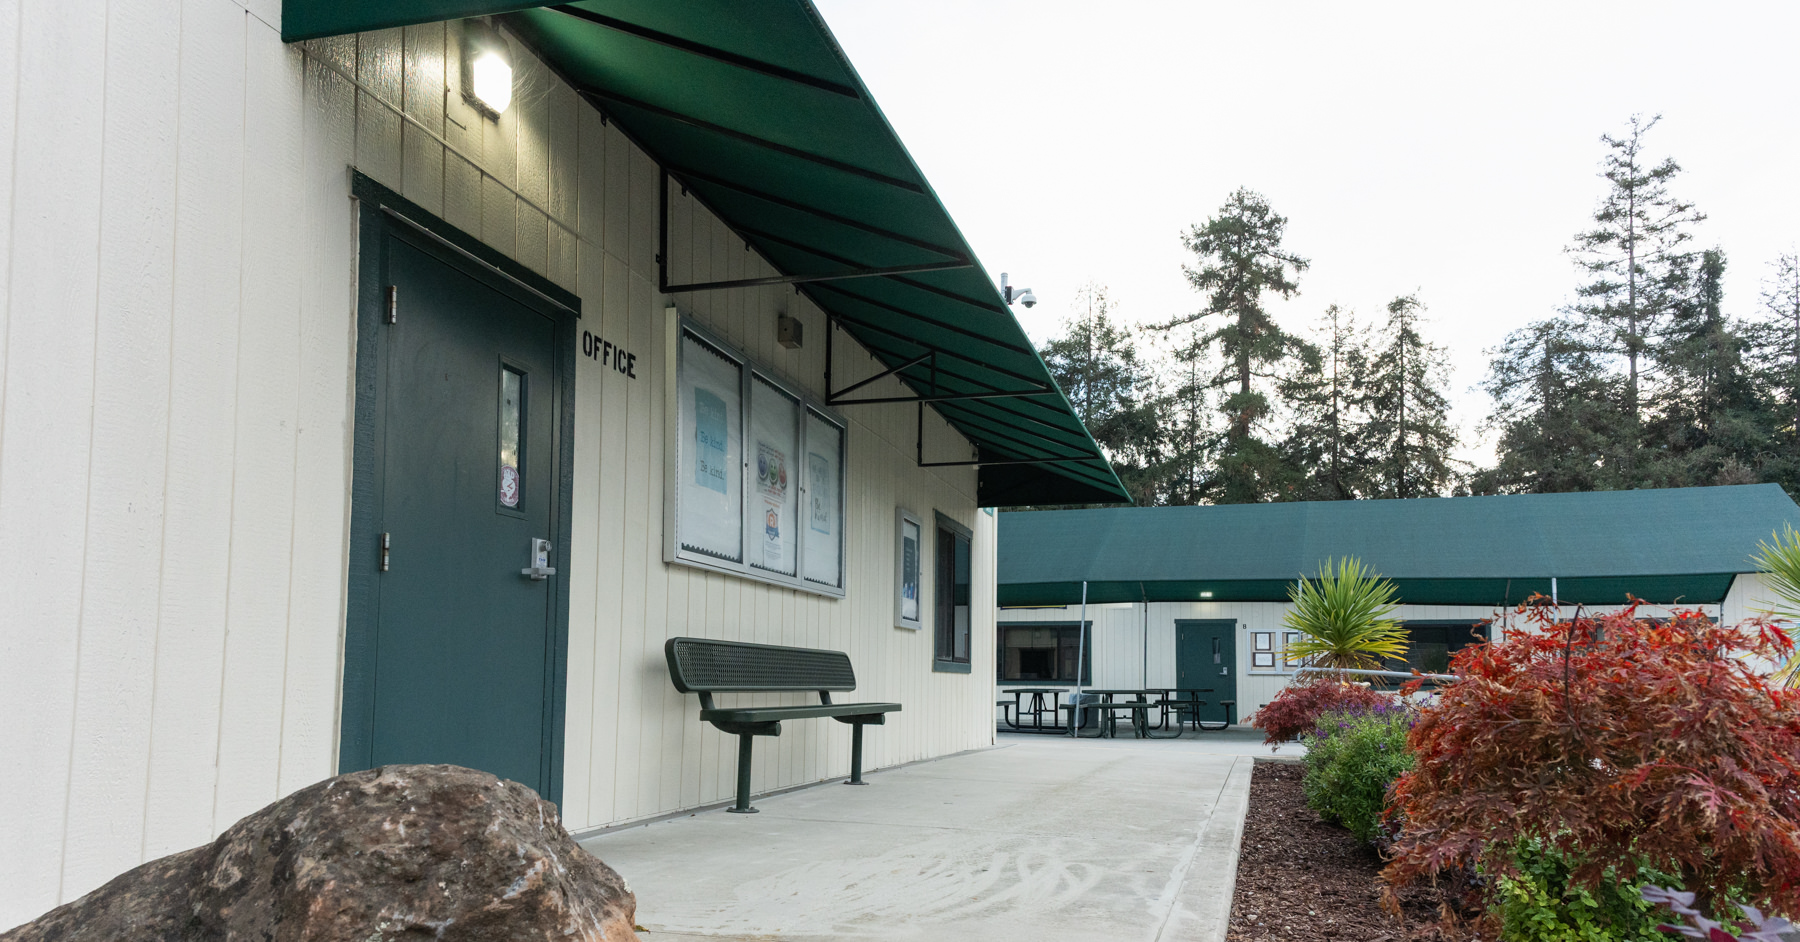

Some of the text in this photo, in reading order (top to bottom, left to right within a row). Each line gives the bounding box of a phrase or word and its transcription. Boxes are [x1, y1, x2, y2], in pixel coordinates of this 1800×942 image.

[582, 330, 637, 380] OFFICE
[700, 430, 709, 444] Be
[700, 460, 708, 473] Be
